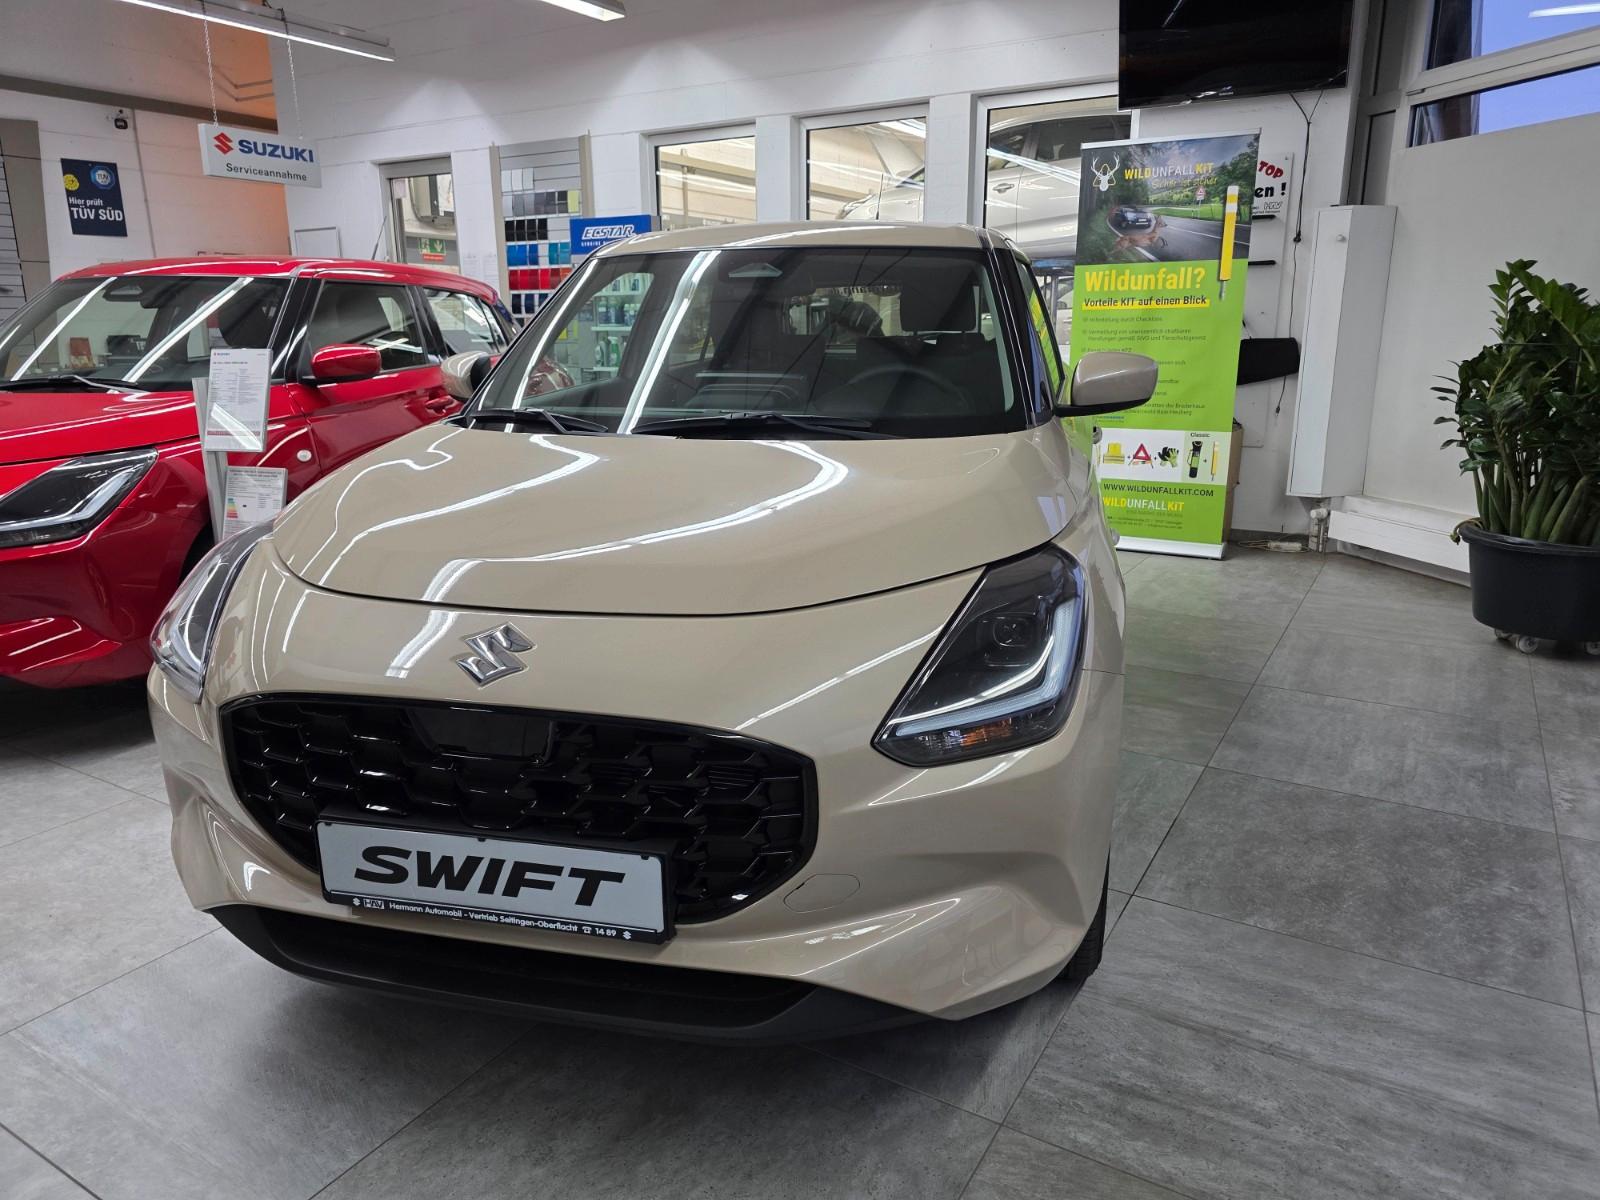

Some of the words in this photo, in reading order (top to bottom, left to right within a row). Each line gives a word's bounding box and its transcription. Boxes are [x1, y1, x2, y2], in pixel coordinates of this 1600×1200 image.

[238, 139, 314, 163] SUZUKI
[226, 162, 307, 181] Serviceannahme
[1124, 162, 1214, 180] WILDUNFALLKIT
[1259, 160, 1284, 179] TOP
[68, 197, 85, 205] Hier
[70, 206, 95, 219] TÜV
[98, 207, 124, 221] SÜD
[581, 225, 634, 240] ECSTAR
[1085, 267, 1206, 292] Wildunfall?
[1084, 296, 1119, 307] Vorteile
[1120, 297, 1136, 306] KIT
[1138, 297, 1153, 306] auf
[1155, 296, 1180, 305] einen
[1183, 295, 1207, 305] Blick
[1103, 483, 1214, 497] WWW.WILDUNFALLKIT.COM
[1103, 496, 1184, 511] WILDUNFALLKIT
[354, 845, 626, 907] SWIFT
[389, 902, 424, 913] Hermann
[425, 907, 463, 918] Automobil
[469, 912, 499, 922] Vertrieb
[595, 927, 605, 935] 14
[606, 928, 617, 937] 89
